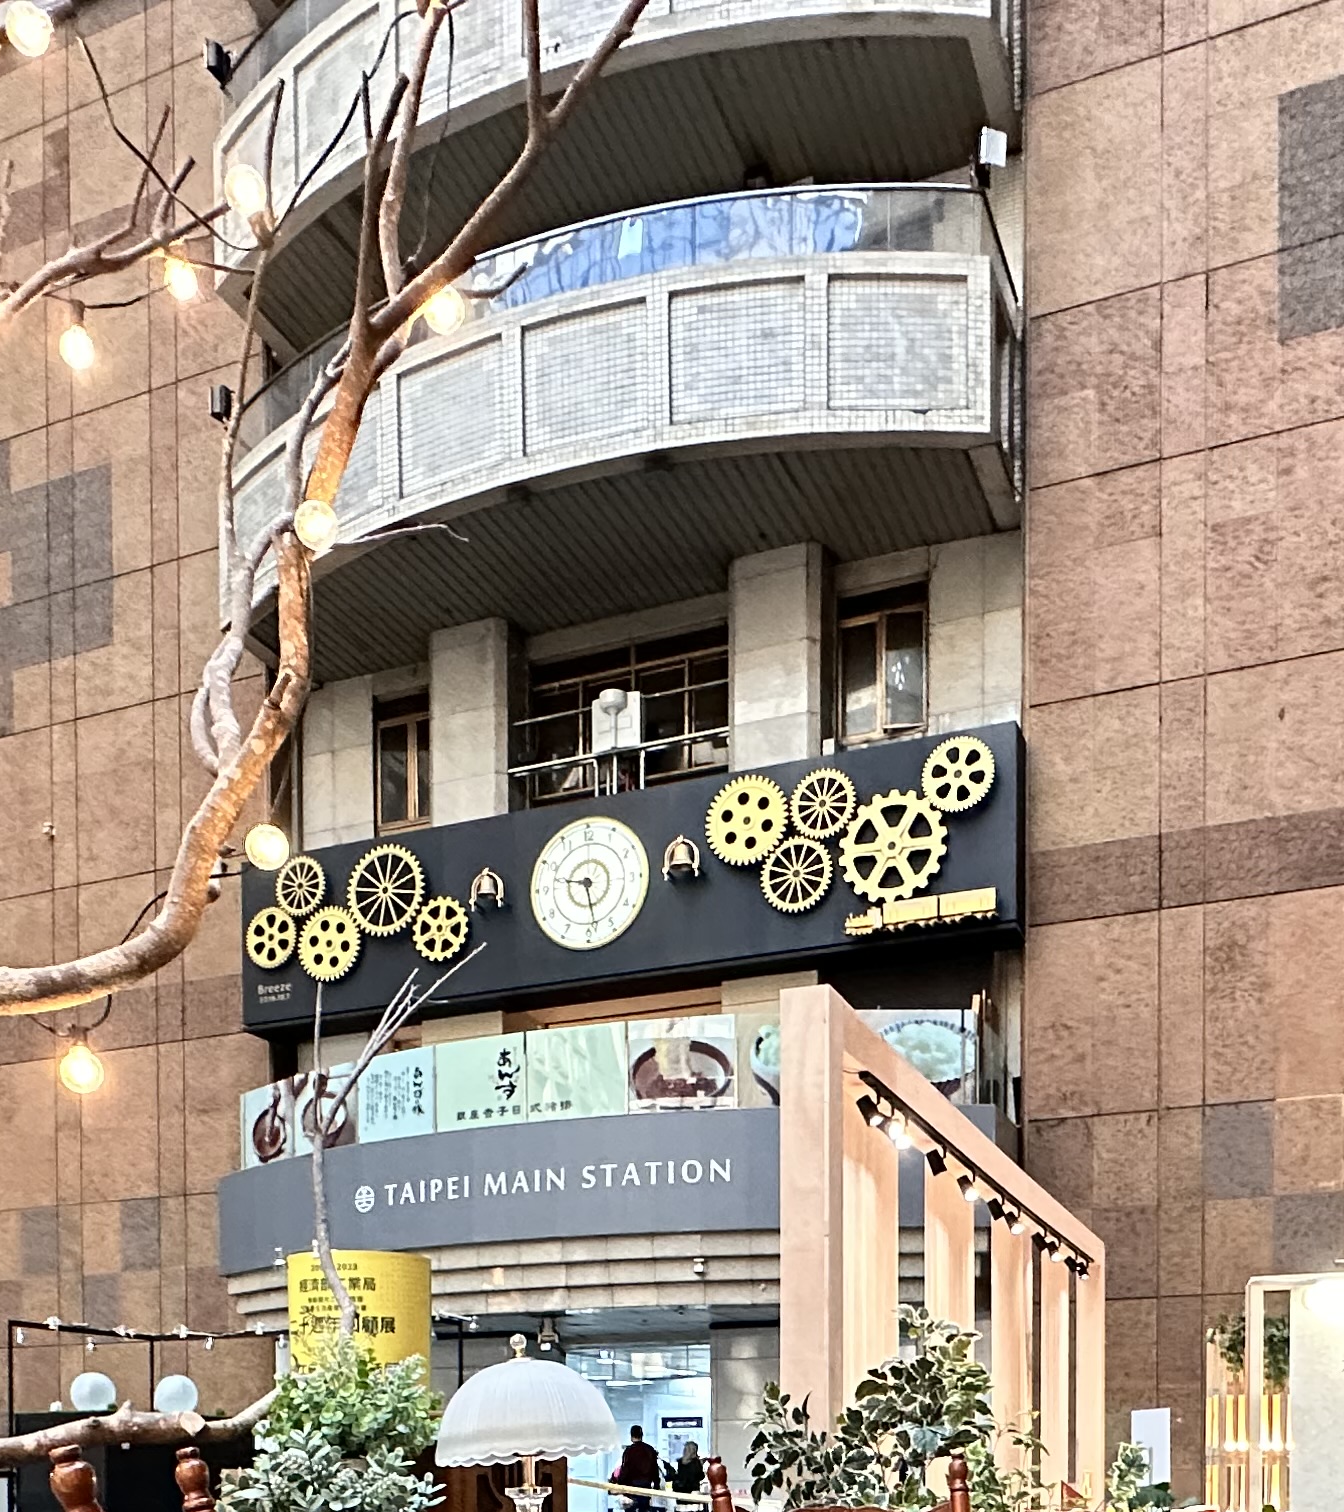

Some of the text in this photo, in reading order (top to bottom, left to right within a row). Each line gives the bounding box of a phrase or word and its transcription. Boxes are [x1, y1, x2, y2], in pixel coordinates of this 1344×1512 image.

[258, 983, 292, 995] Breeze
[384, 1158, 732, 1206] TAIPEI MAIN STATION
